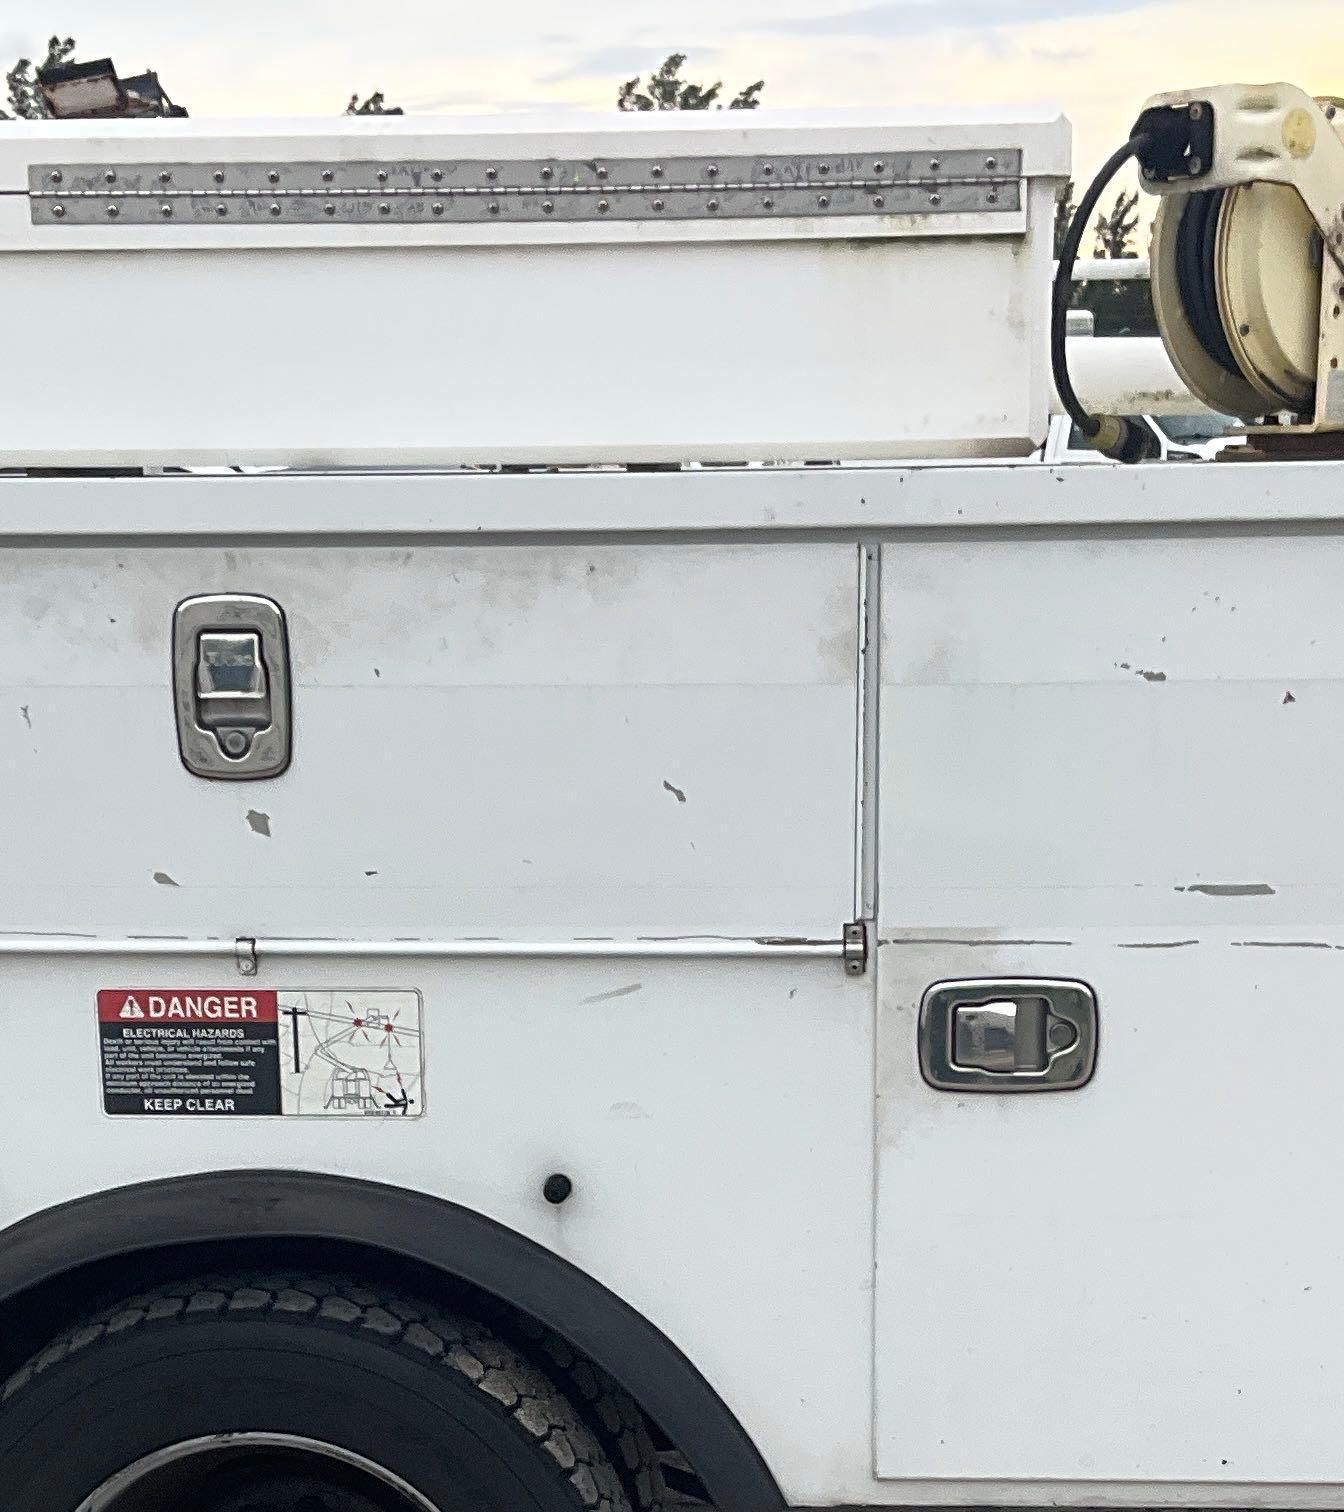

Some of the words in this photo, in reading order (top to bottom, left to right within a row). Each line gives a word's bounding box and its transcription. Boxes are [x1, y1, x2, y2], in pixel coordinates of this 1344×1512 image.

[148, 996, 258, 1019] DANGER
[122, 1028, 189, 1039] ELECTRICAL
[191, 1029, 244, 1039] HAZARDS
[143, 1099, 184, 1111] KEEP
[186, 1099, 235, 1111] CLEAR
